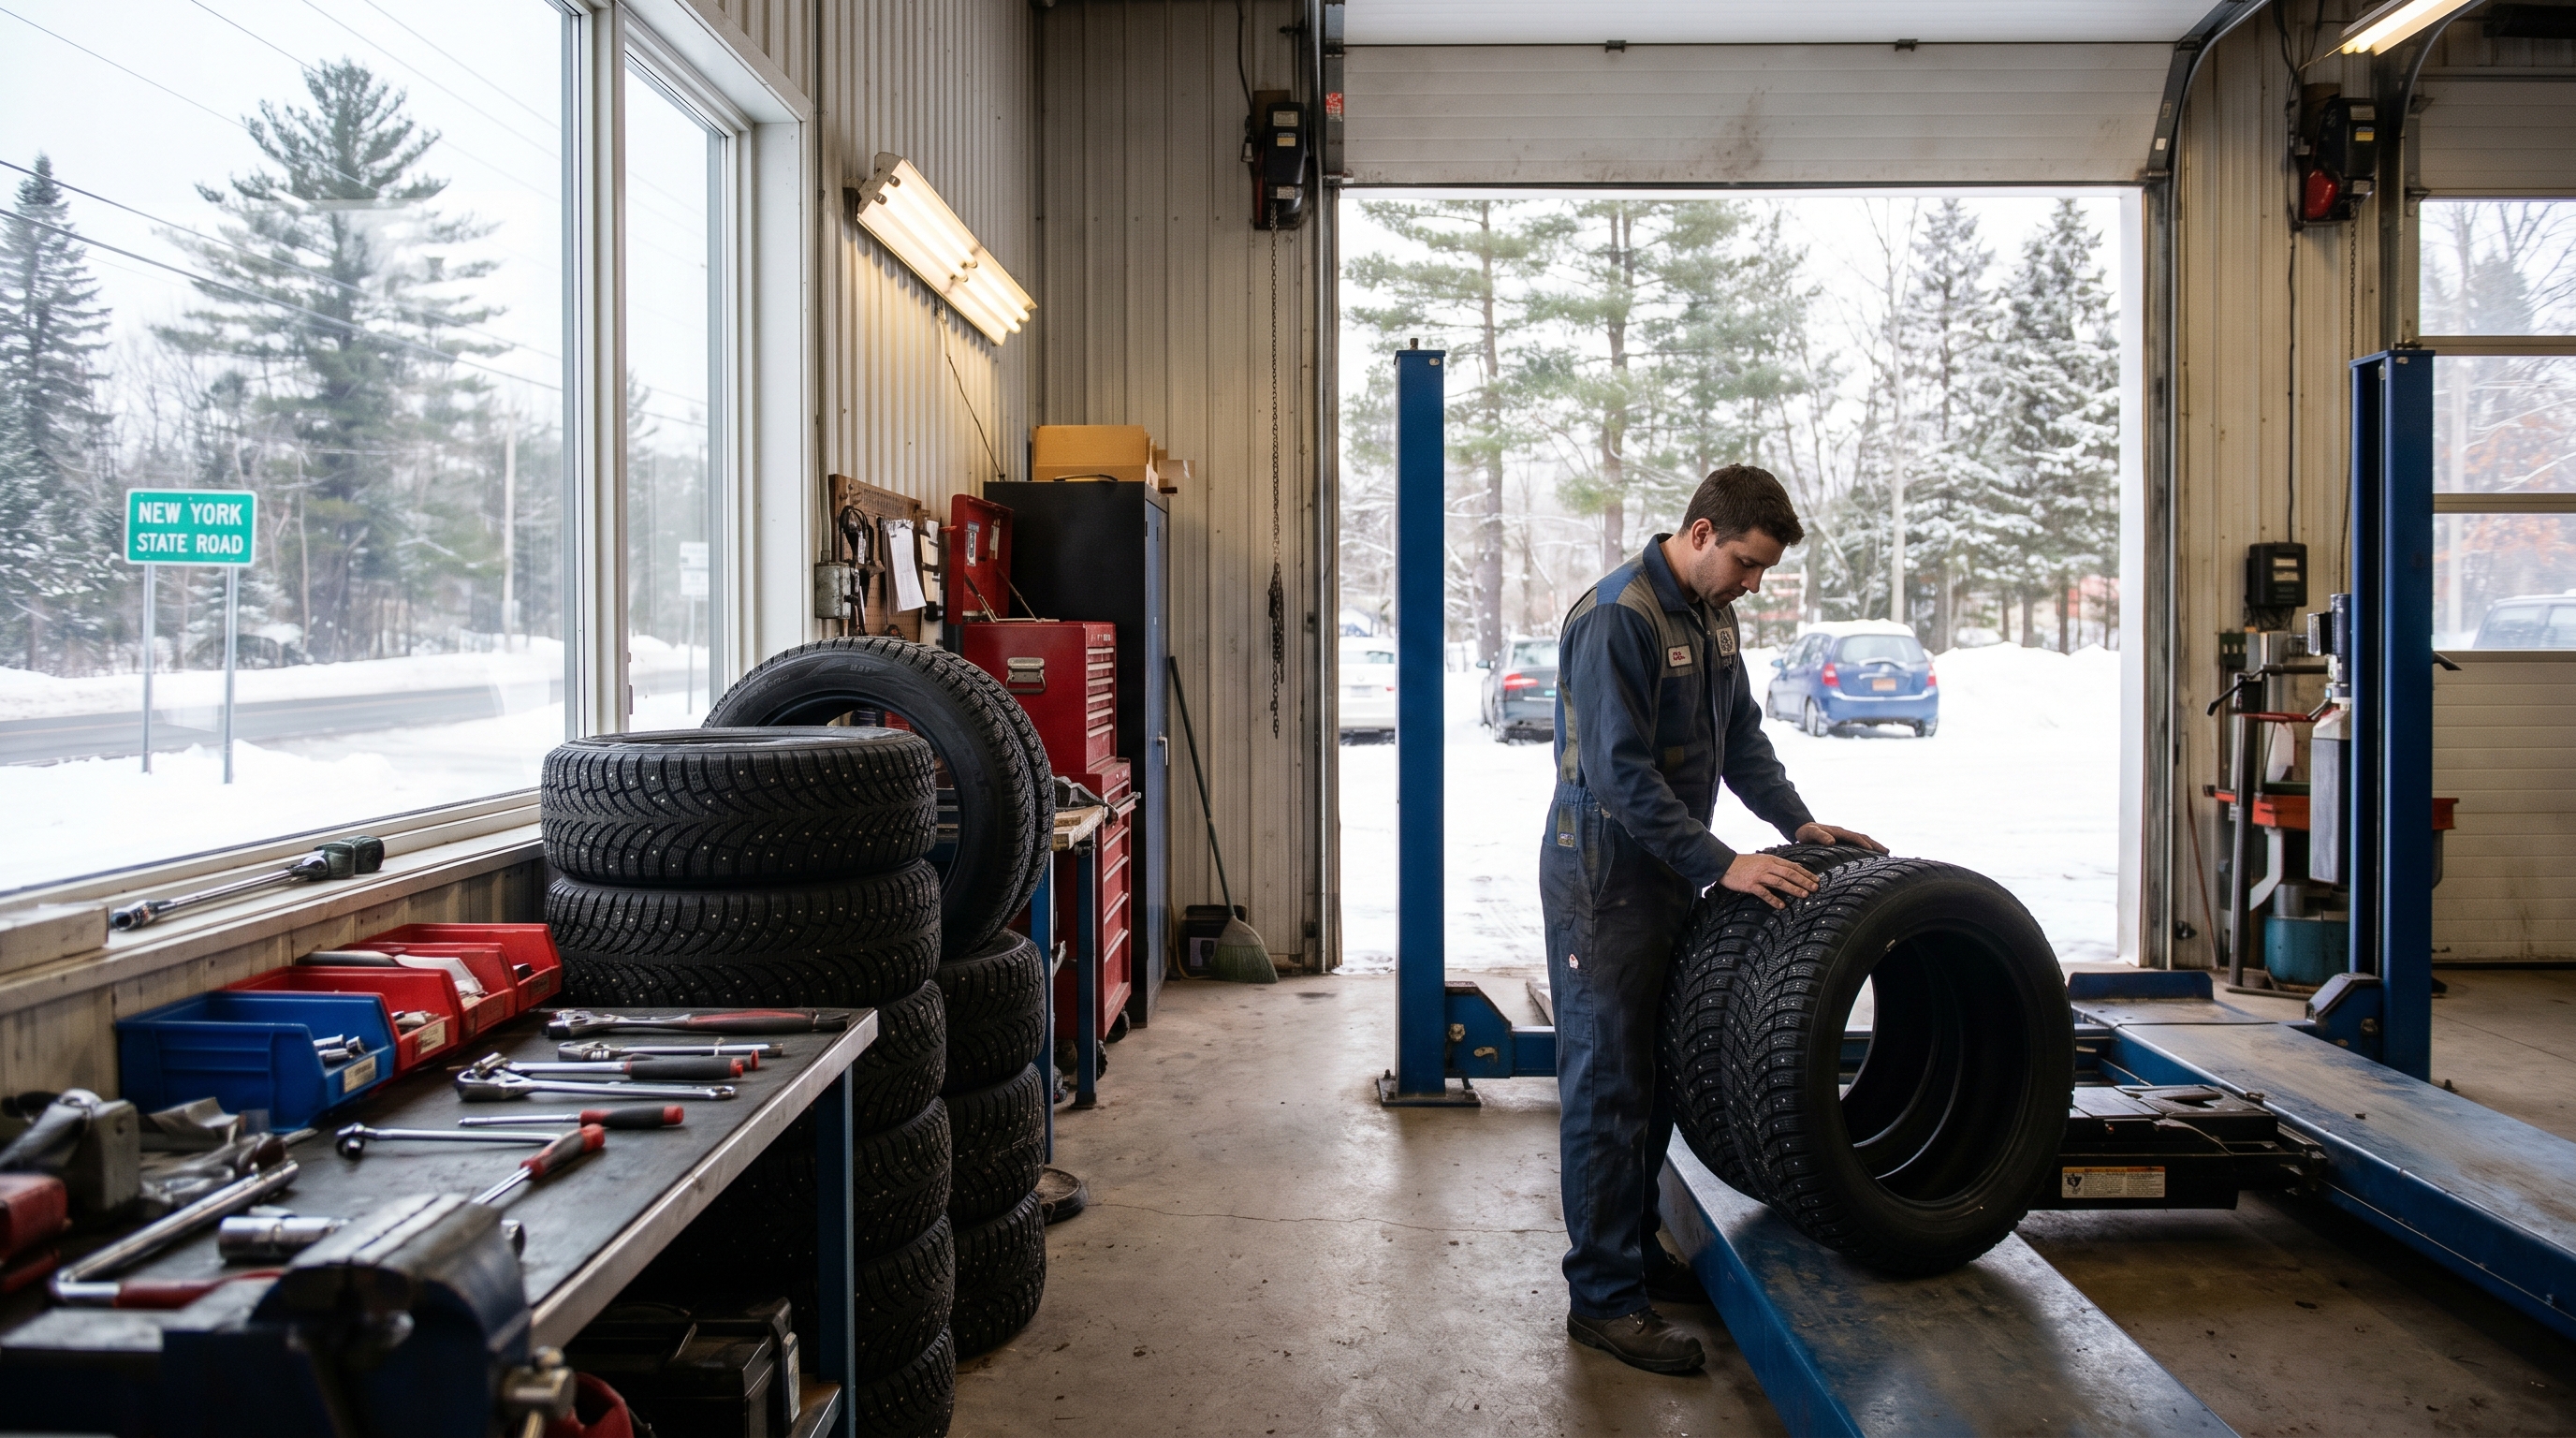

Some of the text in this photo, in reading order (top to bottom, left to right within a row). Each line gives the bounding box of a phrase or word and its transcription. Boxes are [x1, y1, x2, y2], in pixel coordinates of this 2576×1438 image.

[139, 502, 242, 525] NEW YORK
[137, 533, 243, 554] STATE ROAD
